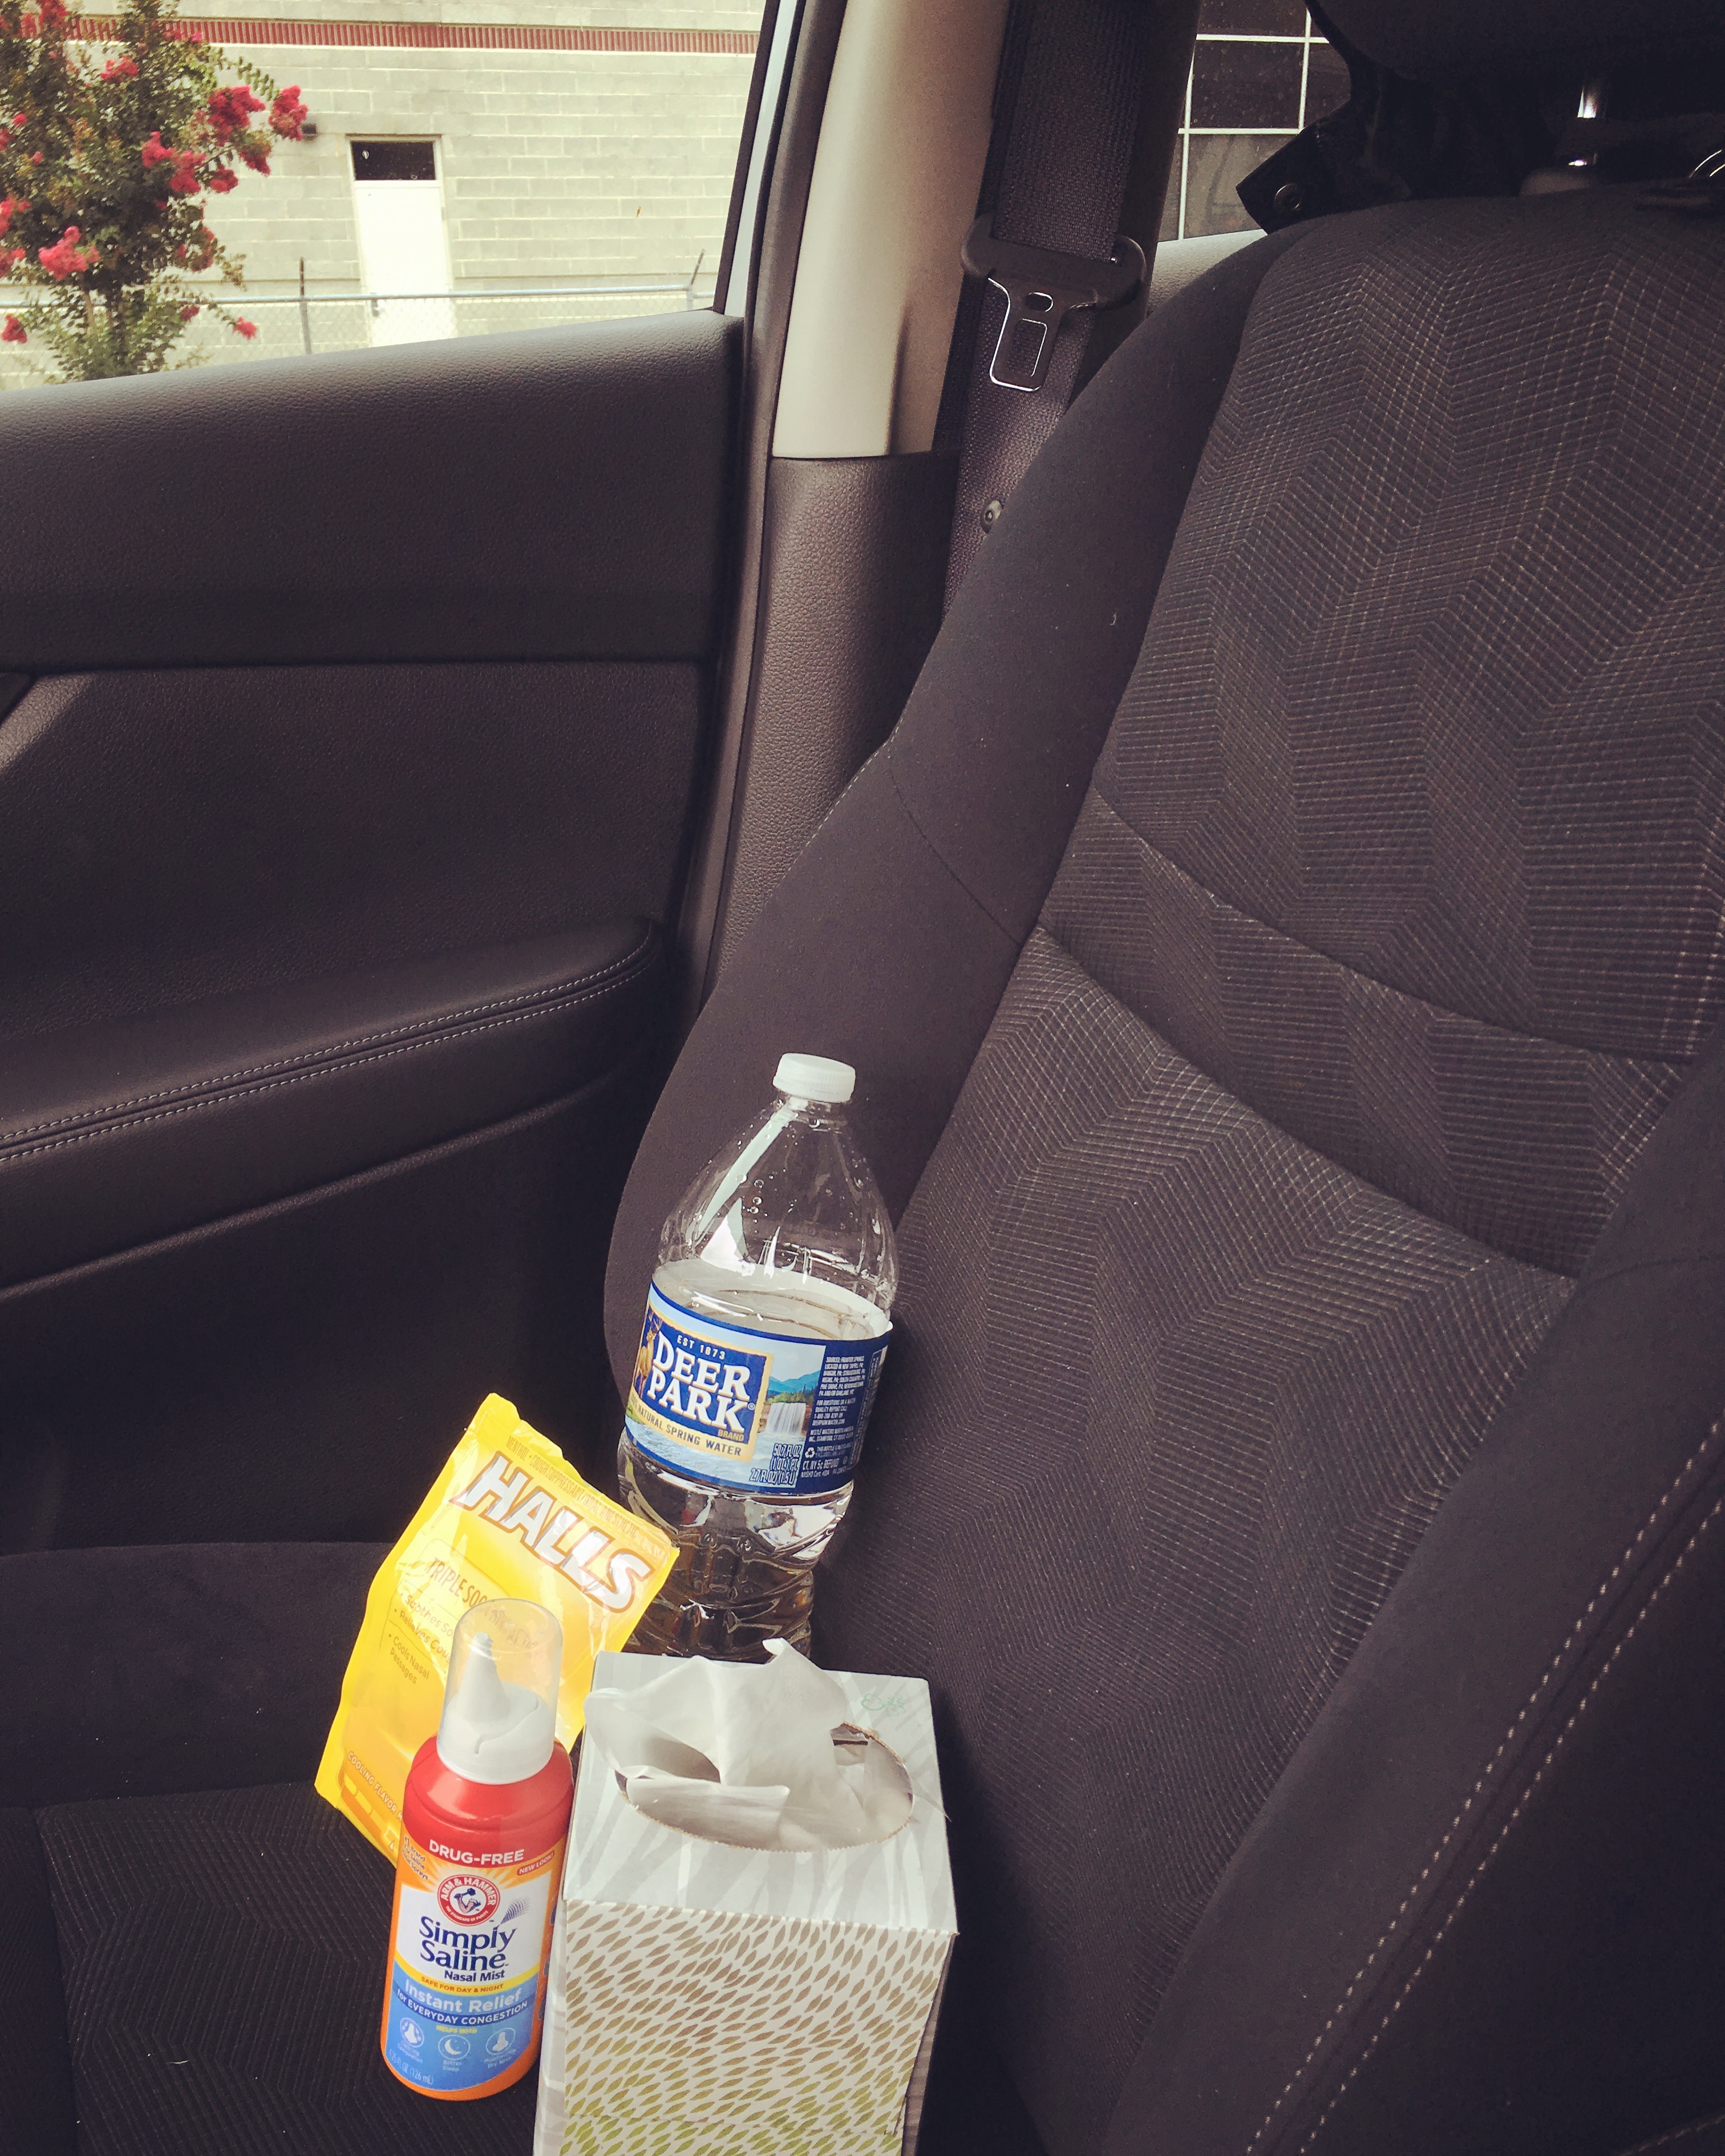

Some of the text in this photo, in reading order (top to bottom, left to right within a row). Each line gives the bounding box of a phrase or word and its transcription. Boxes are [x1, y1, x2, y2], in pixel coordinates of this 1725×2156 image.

[677, 1335, 726, 1360] EST 1873
[653, 1331, 750, 1401] DEER
[647, 1365, 748, 1433] PARK
[638, 1405, 663, 1430] NATURAL
[666, 1424, 701, 1445] SPRING
[705, 1439, 742, 1456] WATER
[718, 1429, 744, 1441] BRAND
[505, 1436, 529, 1461] MENTHOL
[529, 1454, 549, 1475] COUGH
[450, 1450, 655, 1613] HALLS
[426, 1557, 467, 1598] TRIPLE
[400, 1610, 430, 1643] Relieves
[406, 1595, 439, 1628] Soothes
[390, 1647, 417, 1684] Passages
[393, 1635, 430, 1680] Cools Nasal
[348, 1752, 397, 1813] COOLING FLAVOR
[430, 1839, 524, 1865] DRUG-FREE
[519, 1852, 554, 1874] NEW LOOK!
[440, 1877, 496, 1906] ARM & HAMMER
[419, 1916, 517, 1955] Simply
[420, 1940, 507, 1971] Saline
[421, 1976, 438, 1988] SAFE
[440, 1983, 455, 1992] FOR
[480, 1983, 504, 1992] NIGHT
[444, 1969, 505, 1982] Nasal Mist
[397, 1989, 528, 2025] for EVERYDAY CONGESTION
[405, 1979, 522, 2013] Instant Relief
